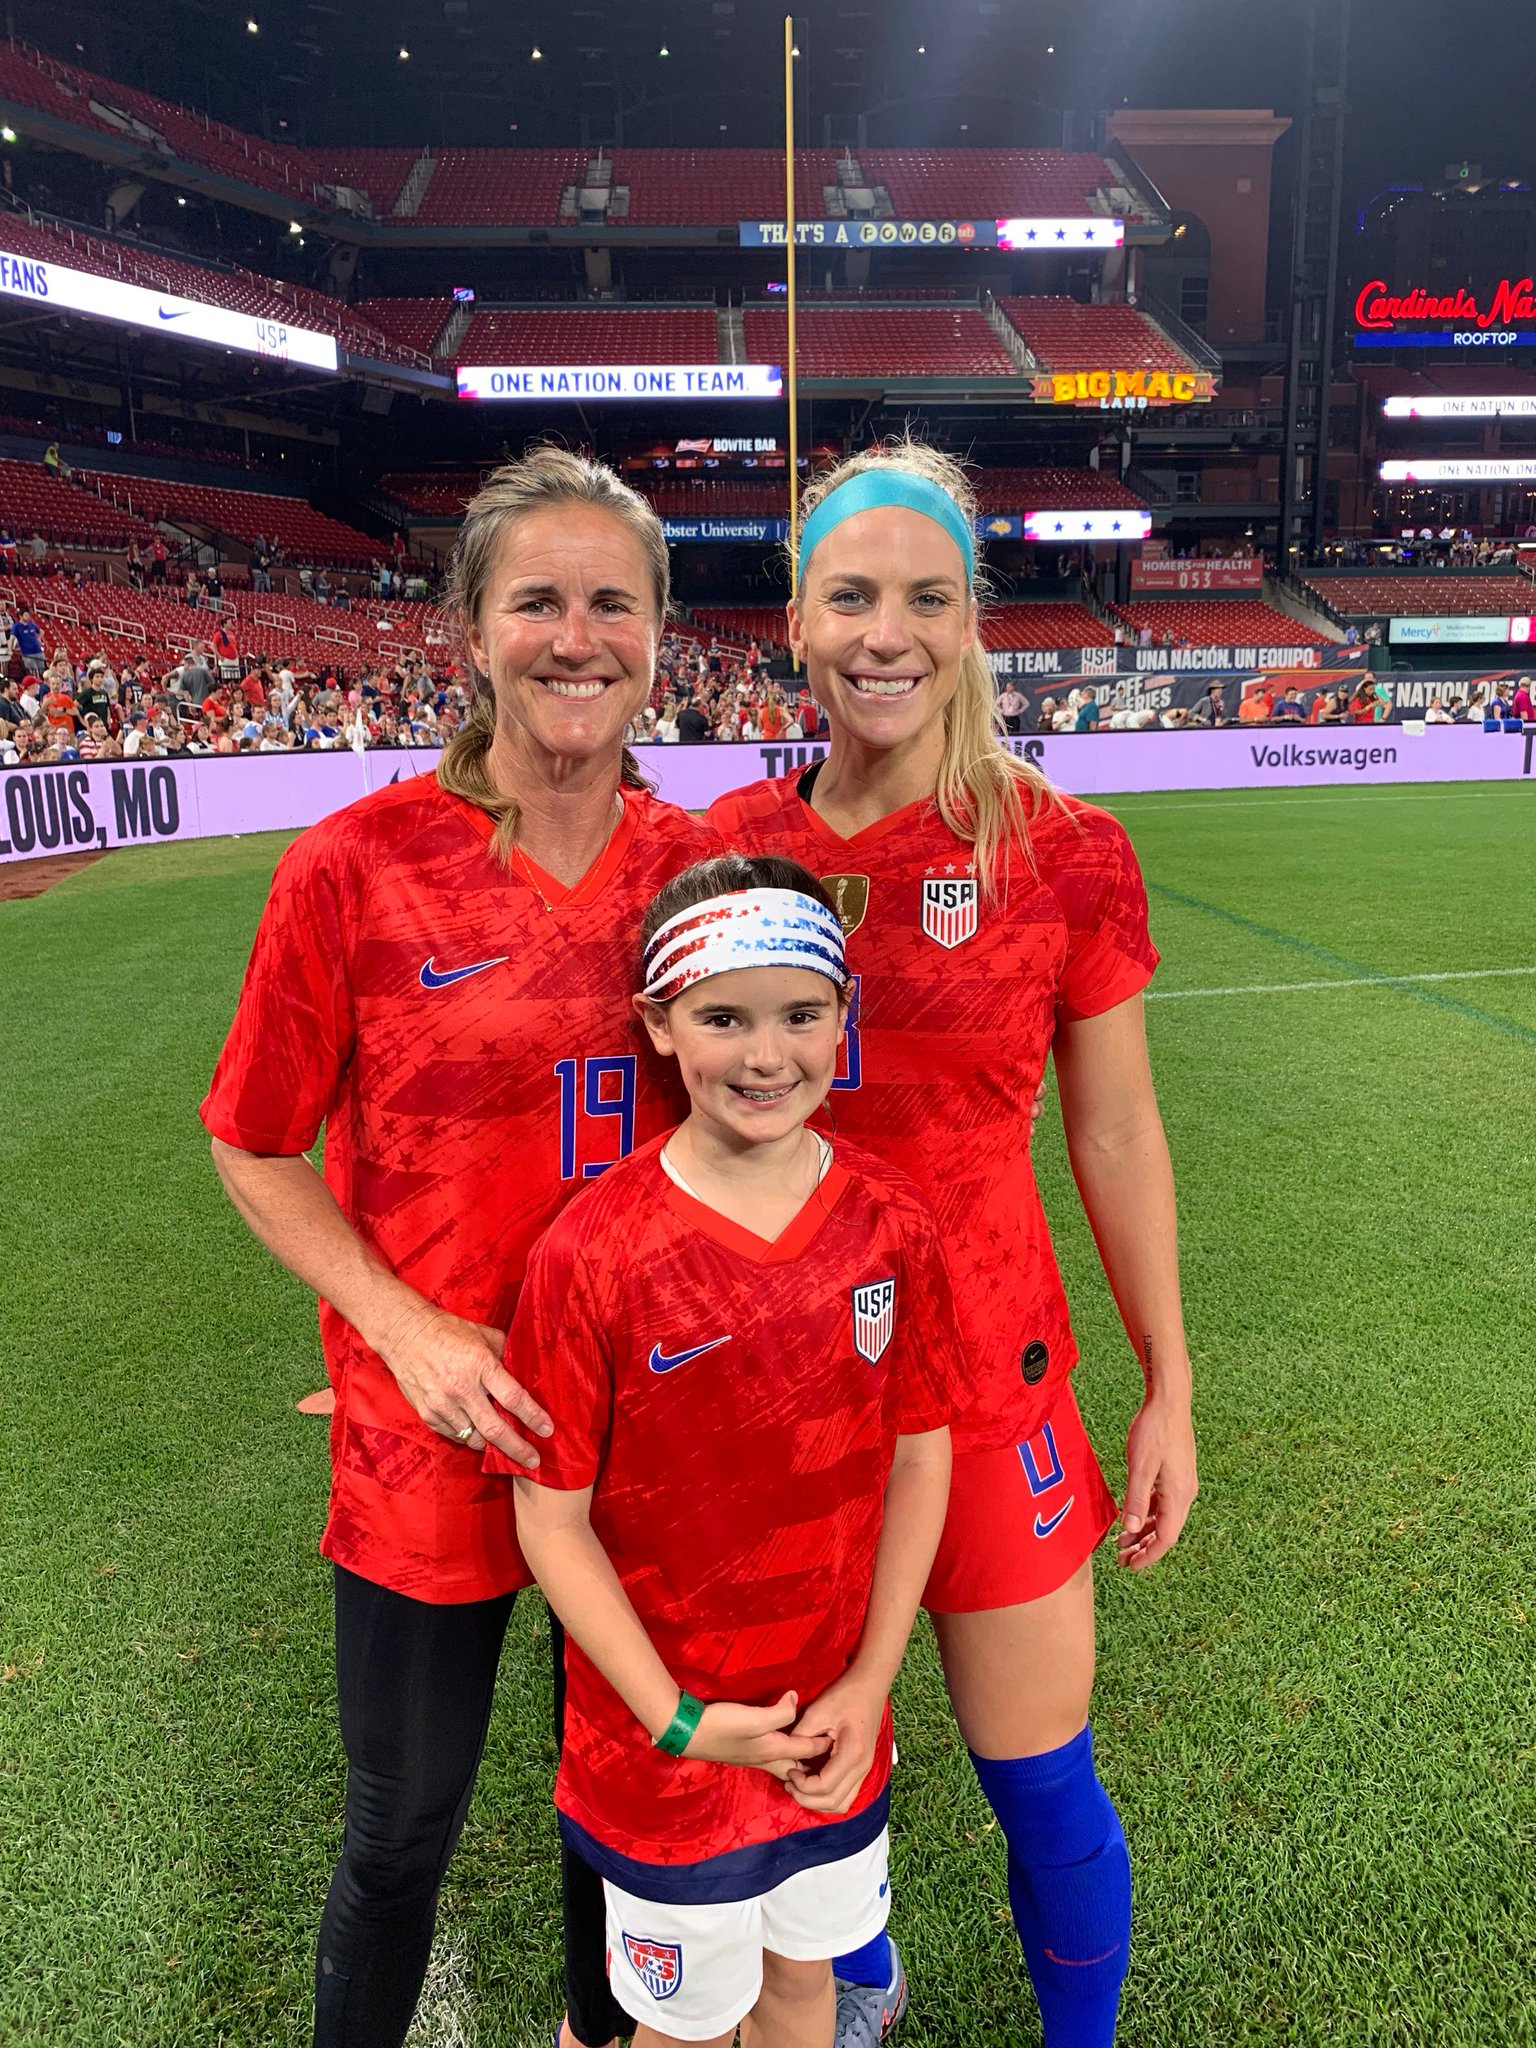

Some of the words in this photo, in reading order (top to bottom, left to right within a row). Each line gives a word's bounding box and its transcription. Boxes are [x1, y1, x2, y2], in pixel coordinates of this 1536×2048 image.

[835, 224, 849, 243] A
[862, 225, 954, 242] POWER
[0, 256, 48, 296] FANS
[1355, 280, 1478, 328] Cardinals
[256, 321, 288, 349] USA
[1453, 332, 1517, 345] ROOFTOP
[491, 372, 534, 393] ONE
[541, 372, 627, 392] NATION.
[634, 371, 676, 392] ONE
[683, 371, 749, 392] TEAM.
[1052, 371, 1111, 402] BIG
[1114, 370, 1198, 401] MAC
[1100, 397, 1148, 409] LAND
[1443, 401, 1466, 412] ONE
[713, 439, 752, 452] BOWTIE
[754, 439, 776, 452] BAR
[1439, 464, 1461, 476] ONE
[660, 522, 698, 537] ebster
[701, 522, 767, 540] University
[1142, 561, 1192, 572] HOMERS
[1207, 560, 1252, 570] HEALTH
[1400, 626, 1433, 639] Mercy
[1015, 652, 1063, 673] TEAM.
[1083, 648, 1114, 666] USA
[1136, 650, 1169, 671] UNA
[1170, 646, 1232, 670] NACIÓN.
[1235, 649, 1256, 669] UN
[1258, 647, 1318, 668] EQUIPO.
[1125, 687, 1172, 712] ERIES
[1250, 743, 1398, 770] Volkswagen
[111, 766, 180, 840] MO
[927, 883, 974, 909] USA
[554, 1055, 638, 1181] 19
[858, 1284, 893, 1318] USA
